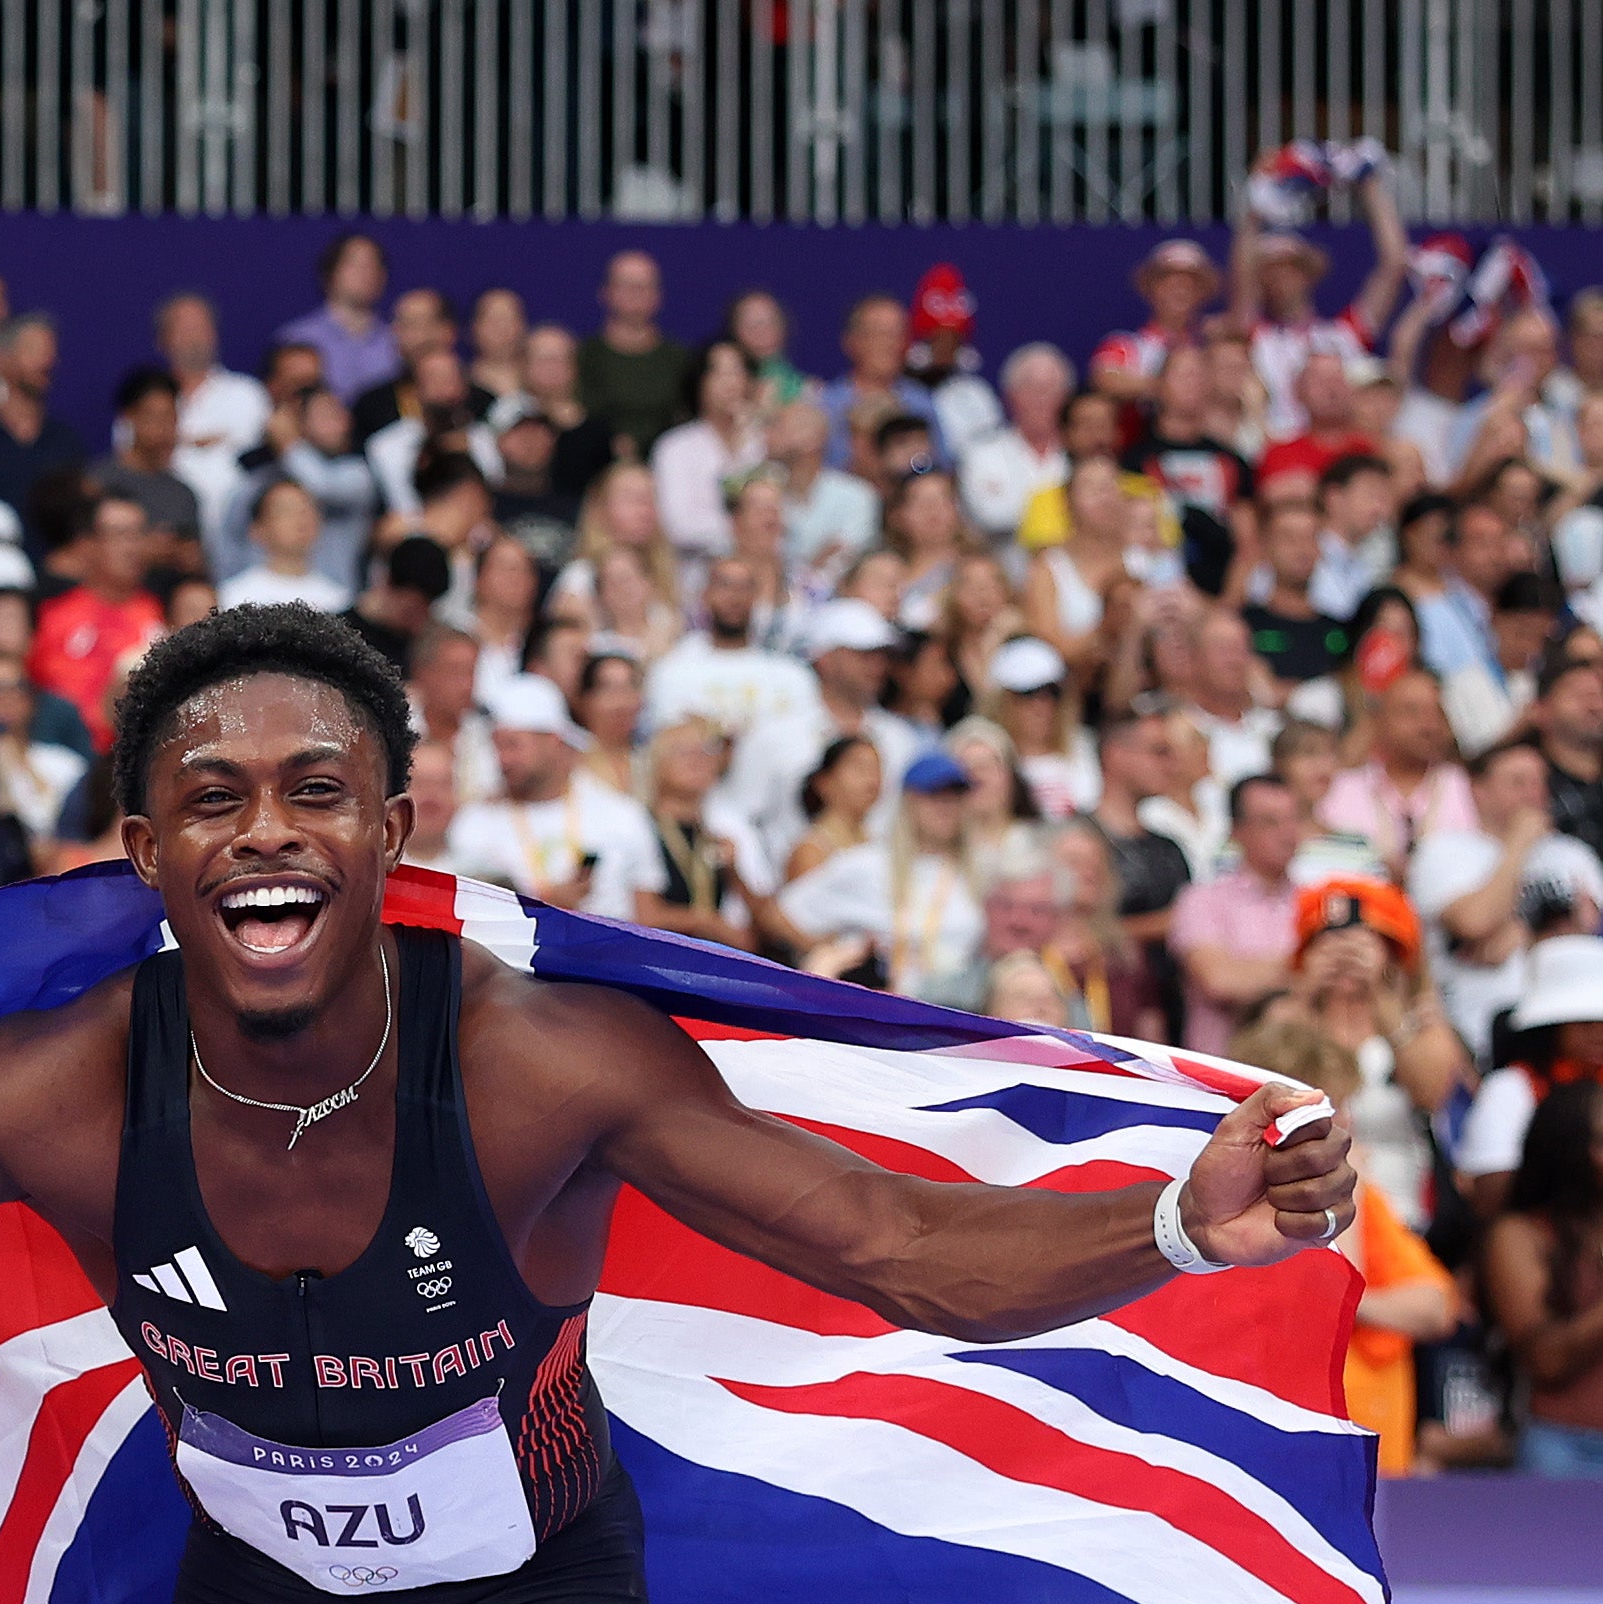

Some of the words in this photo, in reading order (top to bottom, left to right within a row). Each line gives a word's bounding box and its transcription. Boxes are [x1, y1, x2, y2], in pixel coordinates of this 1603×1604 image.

[407, 1263, 436, 1279] TEAM
[436, 1260, 453, 1272] GB
[140, 1321, 291, 1388] GREAT
[313, 1319, 516, 1389] BRITAIN
[252, 1446, 335, 1469] PARIS
[345, 1443, 419, 1469] 2024
[279, 1492, 426, 1548] AZU
